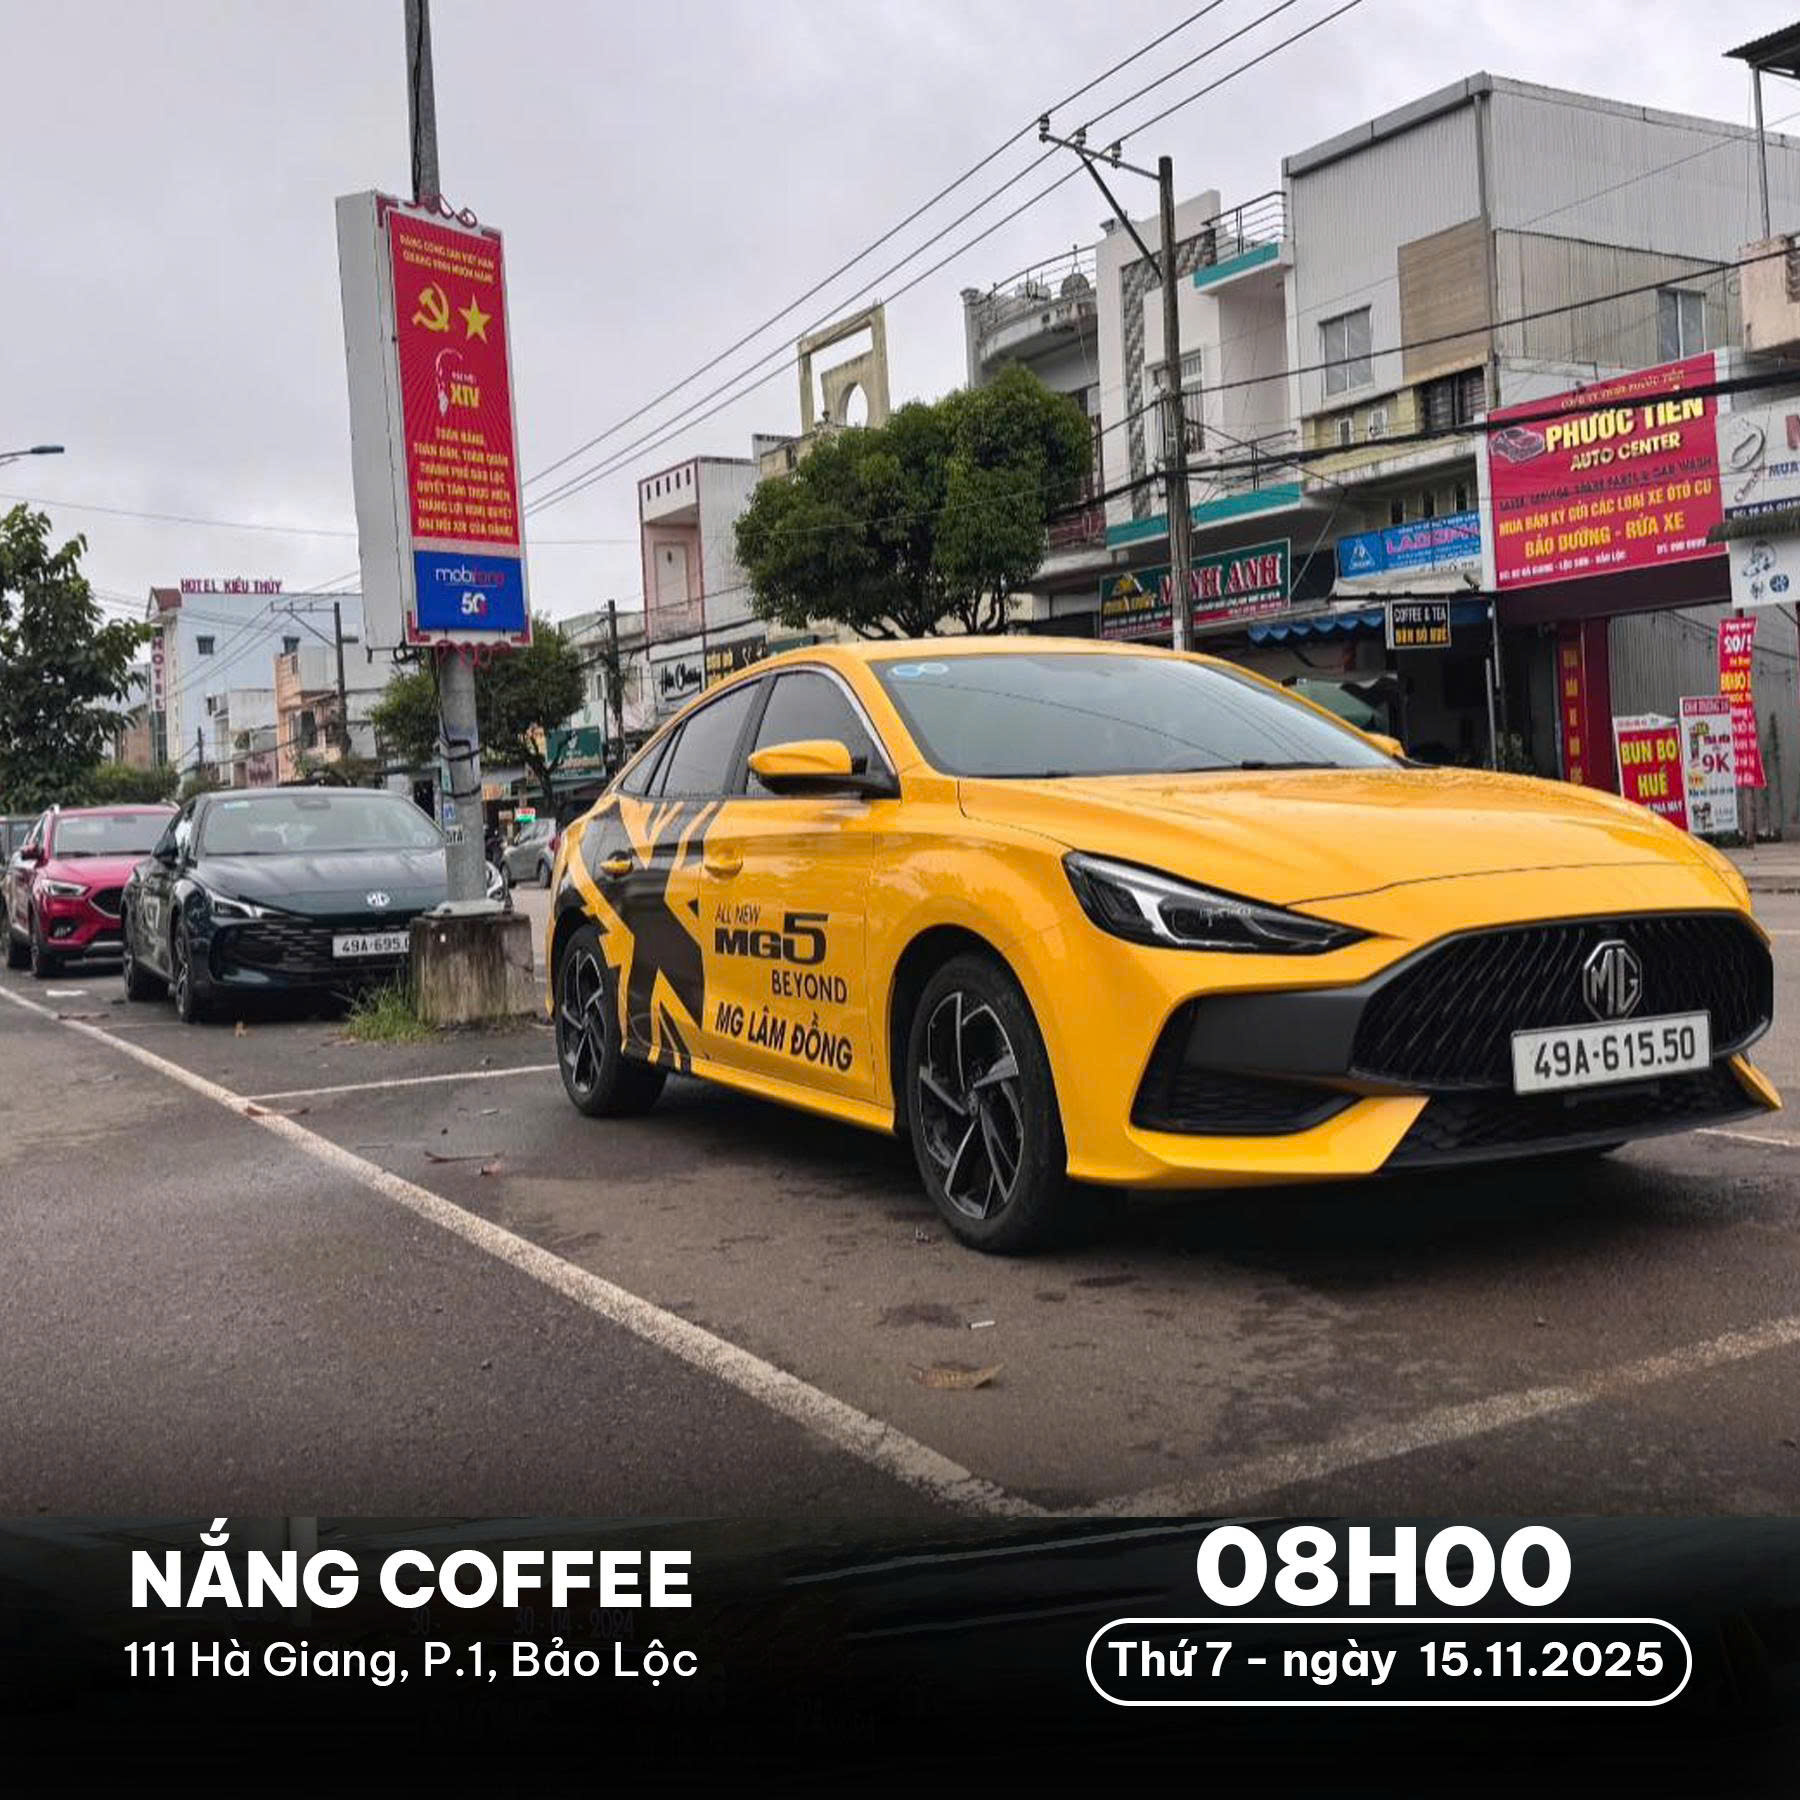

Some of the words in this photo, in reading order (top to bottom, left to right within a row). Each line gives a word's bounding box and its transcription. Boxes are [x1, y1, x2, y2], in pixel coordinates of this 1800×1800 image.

[1571, 448, 1616, 472] AUTO
[1617, 431, 1683, 461] CENTER
[1648, 487, 1665, 506] XE
[1664, 511, 1686, 533] XE
[180, 578, 217, 593] HOTEL
[1224, 553, 1283, 595] ANH
[1394, 607, 1422, 622] COFFEE
[1432, 606, 1447, 621] TEA
[1702, 752, 1731, 774] 9K
[714, 903, 732, 924] ALL
[735, 904, 760, 926] NEW
[714, 911, 829, 966] MG5
[771, 969, 848, 1004] BEYOND
[1590, 948, 1640, 1016] MG
[715, 1001, 745, 1039] MG
[747, 1005, 787, 1052] LÂM
[790, 1011, 853, 1072] ĐỒNG
